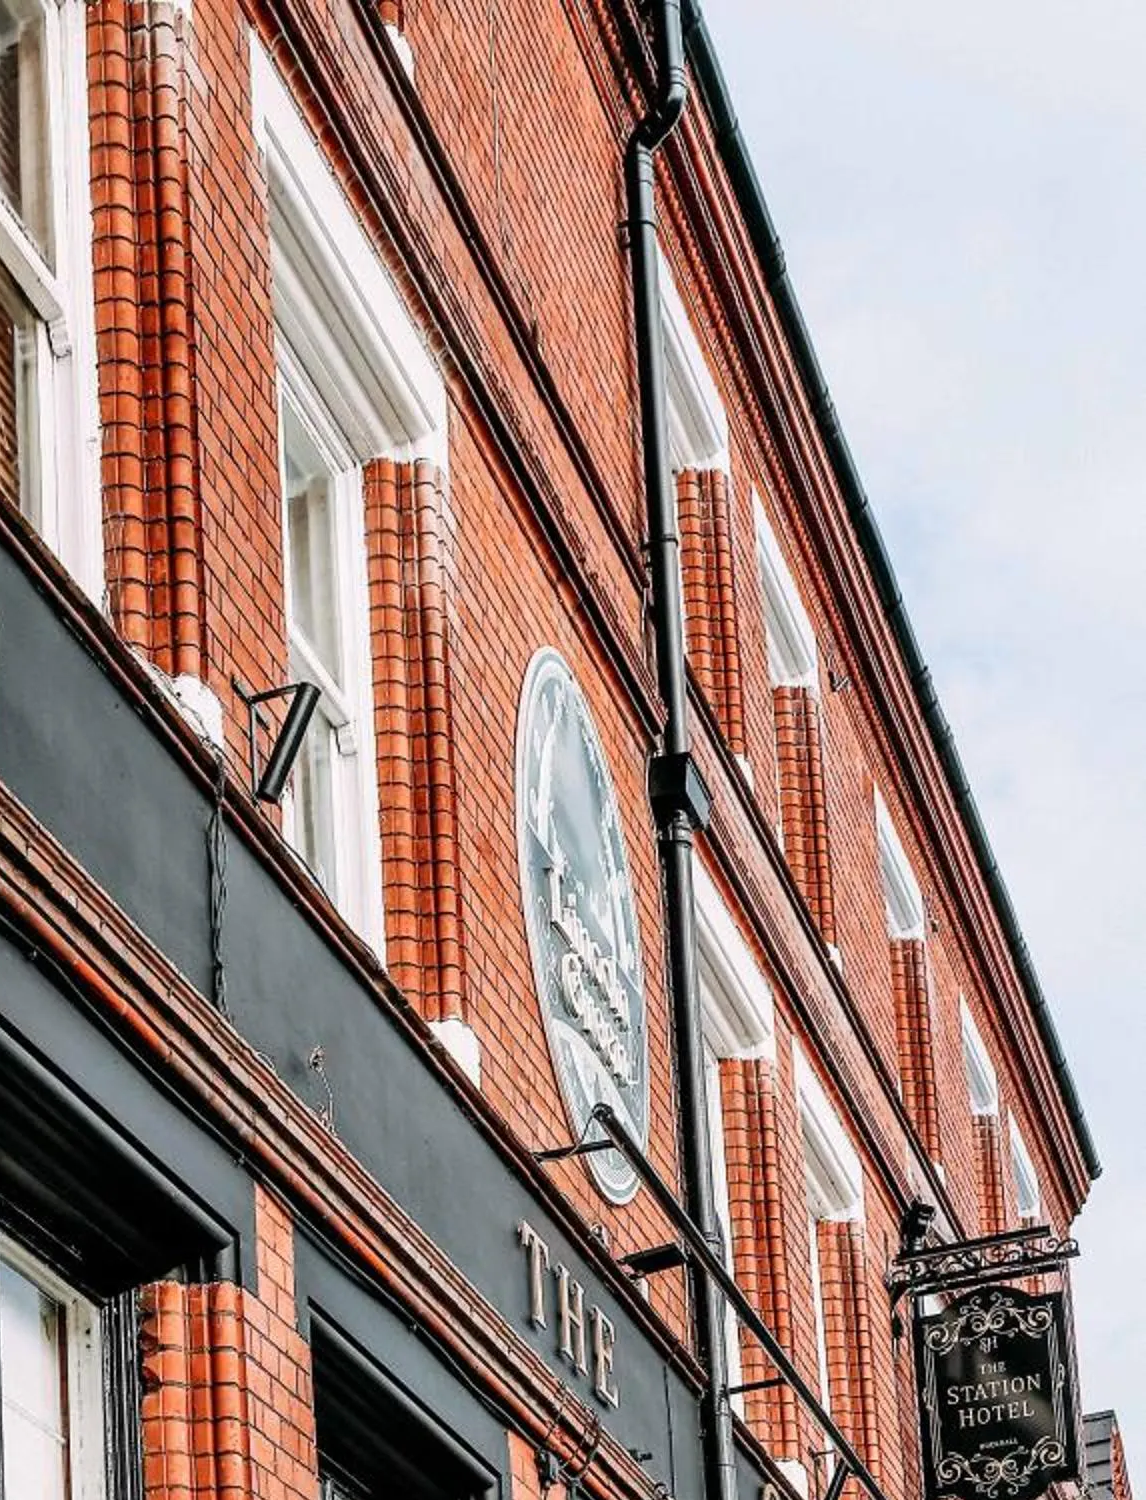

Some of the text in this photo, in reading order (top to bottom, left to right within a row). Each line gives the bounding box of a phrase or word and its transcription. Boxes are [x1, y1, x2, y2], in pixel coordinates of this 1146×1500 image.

[517, 1218, 619, 1409] THE
[947, 1373, 1041, 1405] STATION
[958, 1401, 1035, 1429] HOTEL
